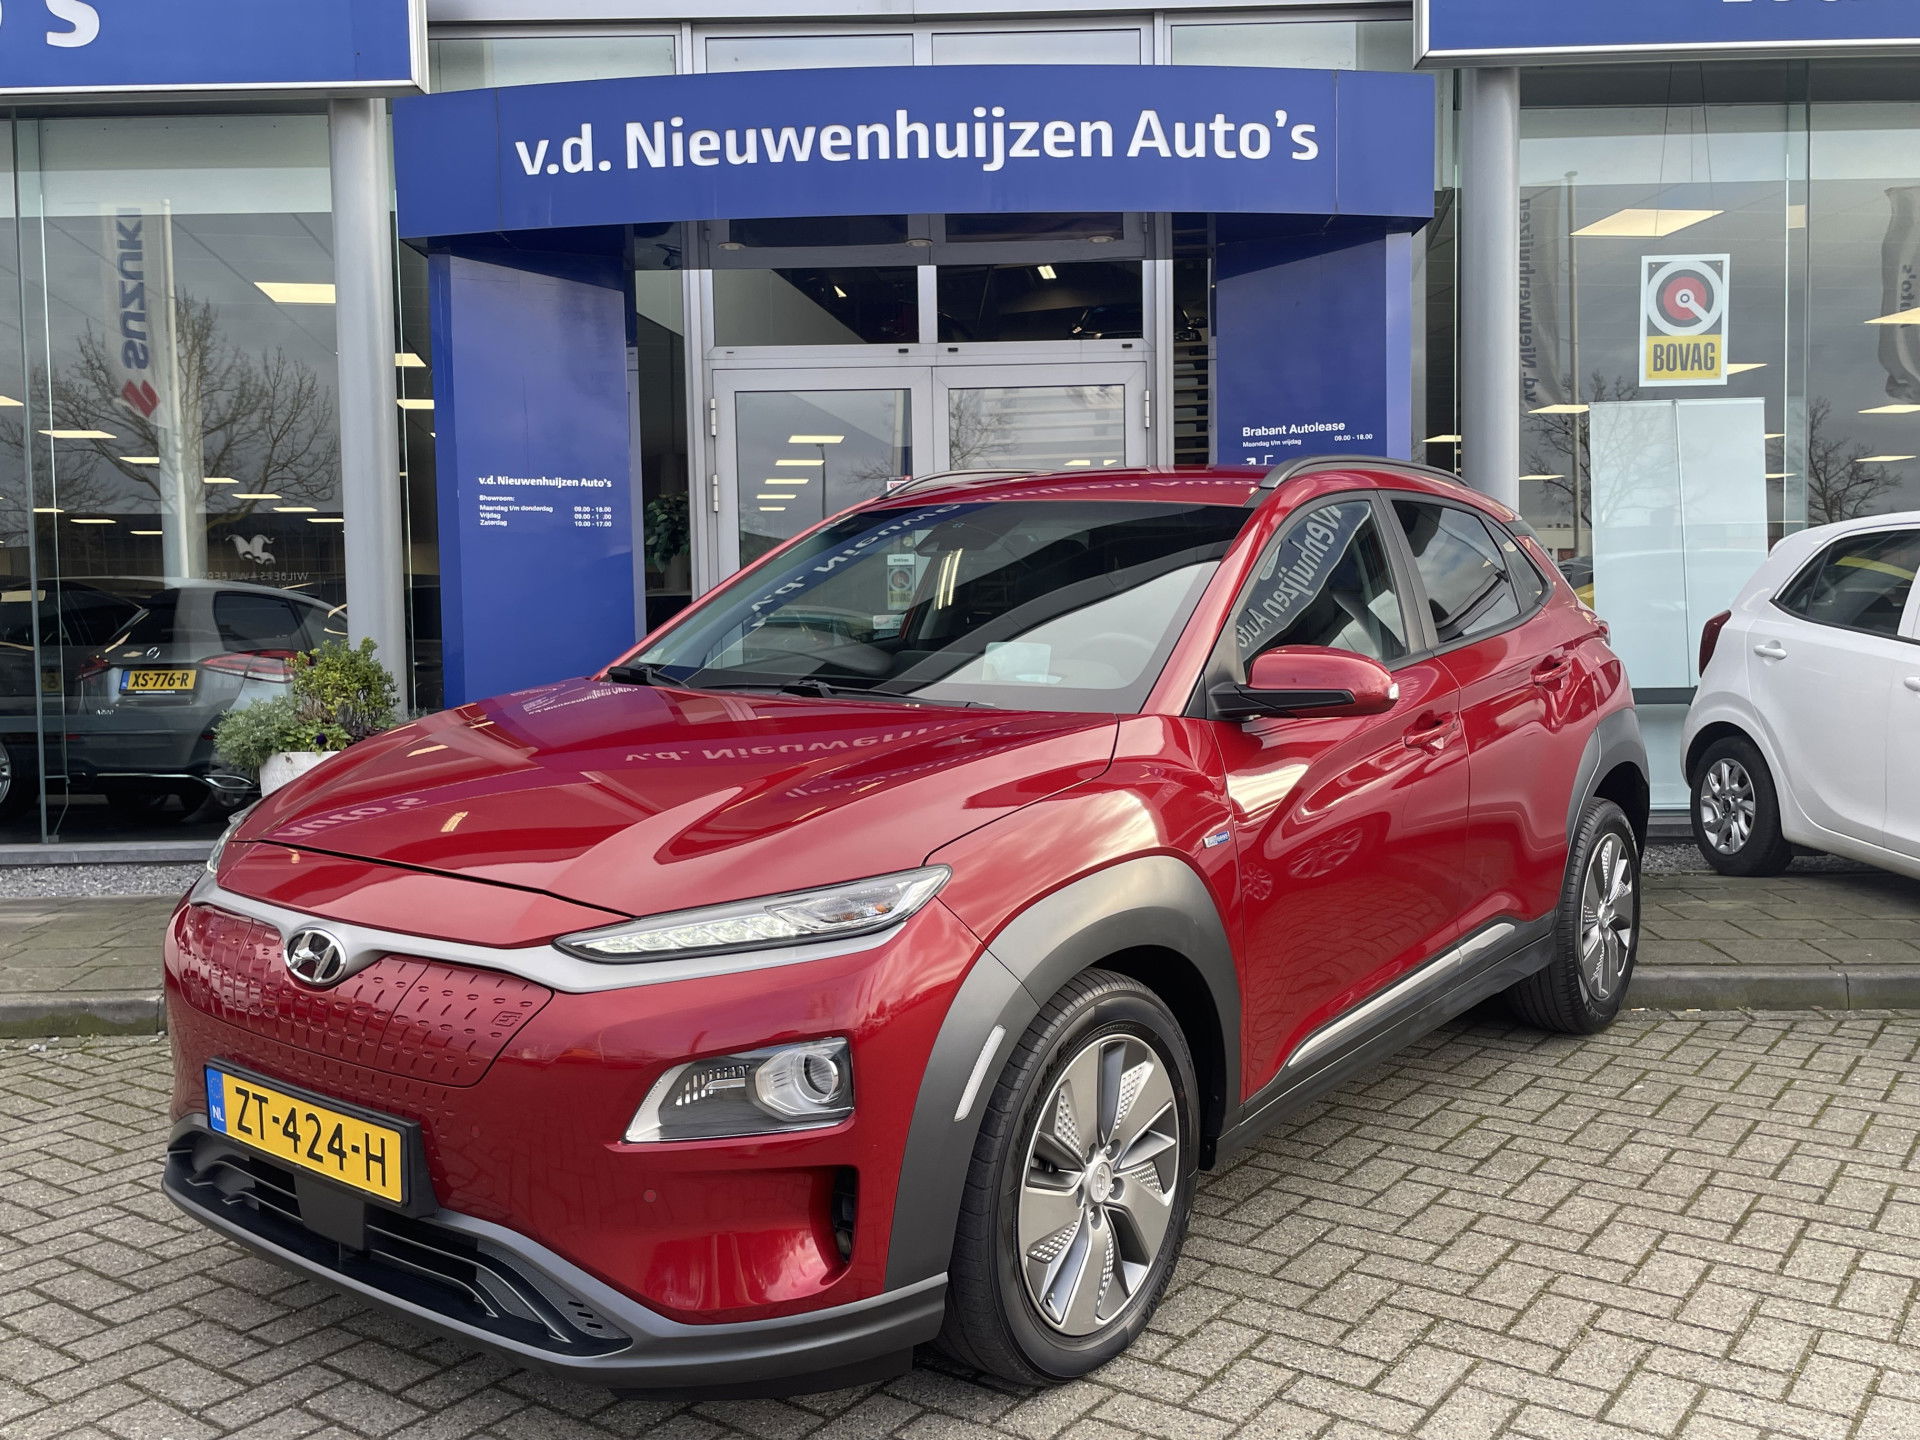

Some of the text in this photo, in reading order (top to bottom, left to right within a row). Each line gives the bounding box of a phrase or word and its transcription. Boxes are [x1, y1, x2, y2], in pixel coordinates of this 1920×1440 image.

[514, 106, 1319, 176] v.d. Nieuwenhuijzen Auto's
[1652, 342, 1716, 372] BOVAG
[1242, 422, 1346, 437] Brabant Autolease
[478, 475, 612, 488] v.d. Nieuwenhuijzen Auto's
[131, 672, 190, 688] XS-776-R
[212, 1104, 225, 1122] NL
[235, 1085, 387, 1188] ZT-424-H
